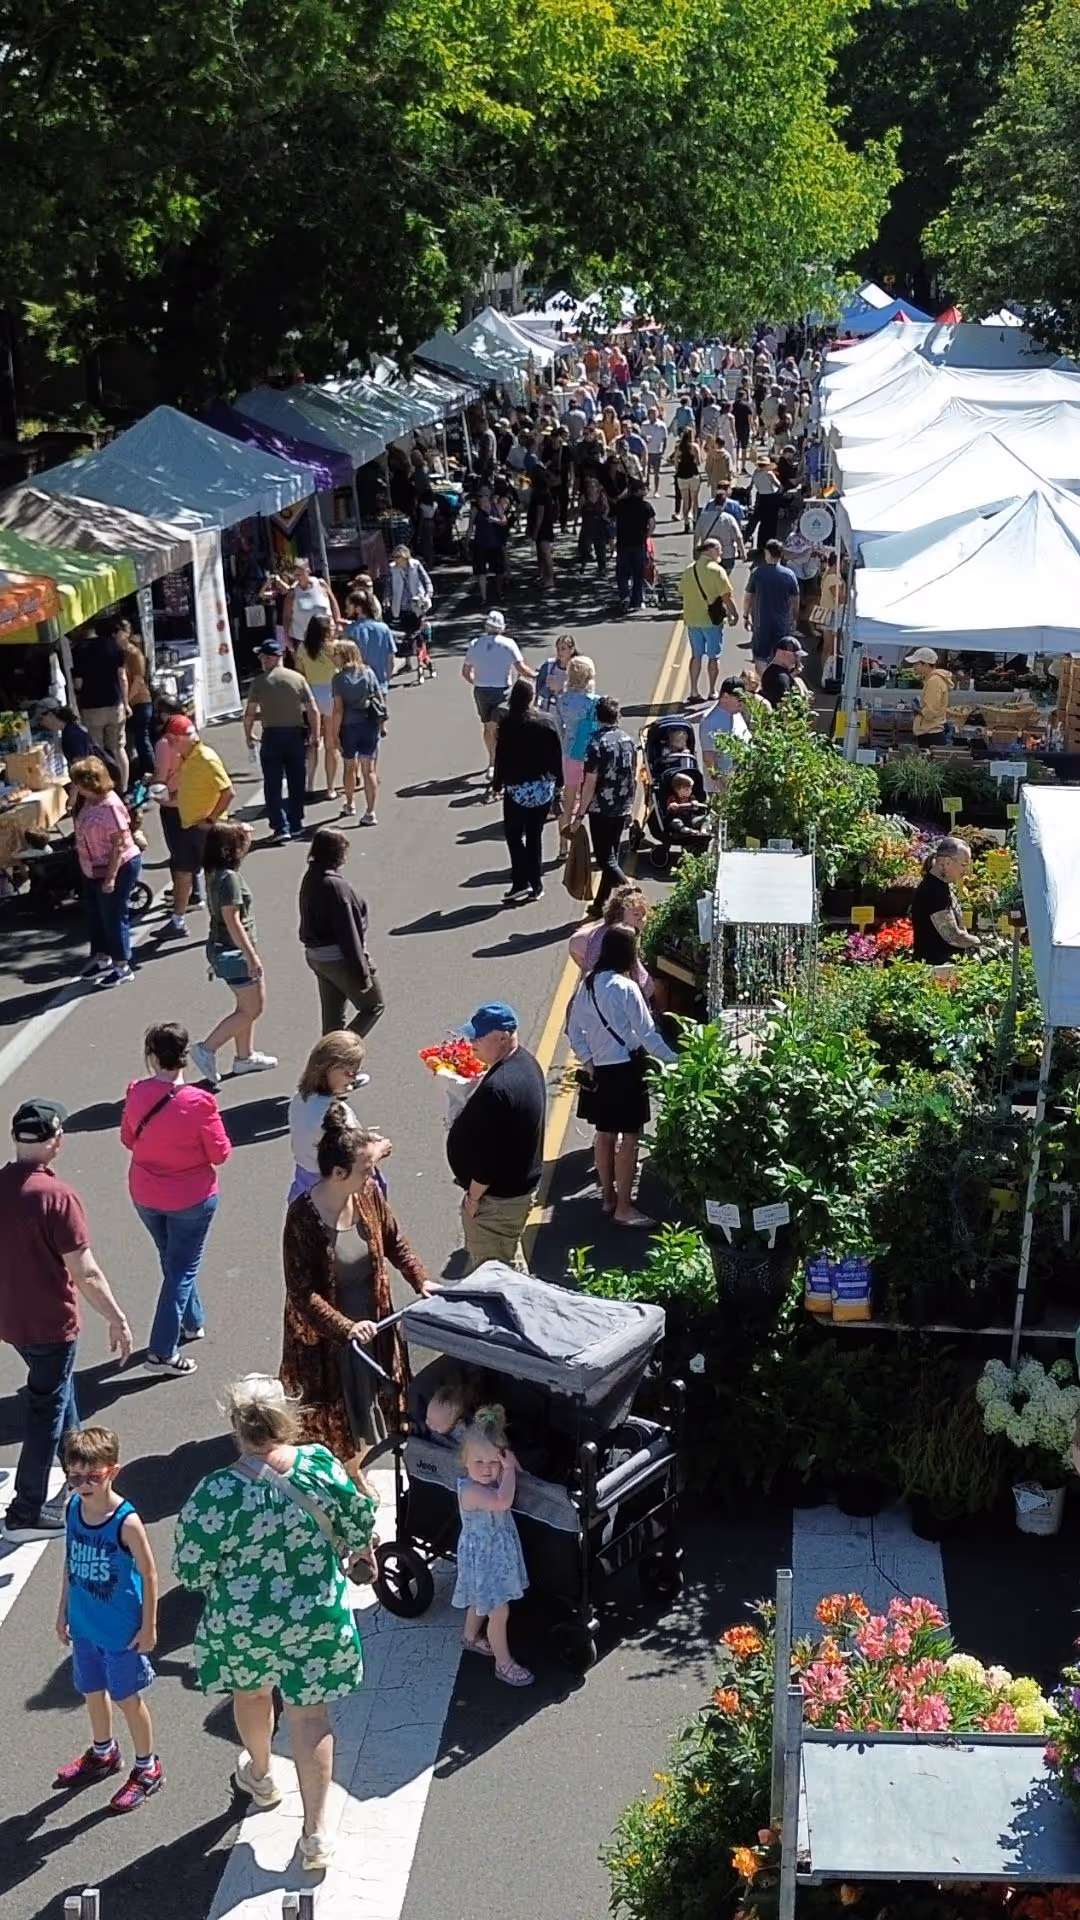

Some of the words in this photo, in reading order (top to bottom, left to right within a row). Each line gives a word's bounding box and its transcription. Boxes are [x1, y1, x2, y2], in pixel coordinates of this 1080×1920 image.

[416, 1459, 438, 1472] Jeep
[71, 1539, 110, 1561] CHILL
[70, 1560, 111, 1581] VIBES
